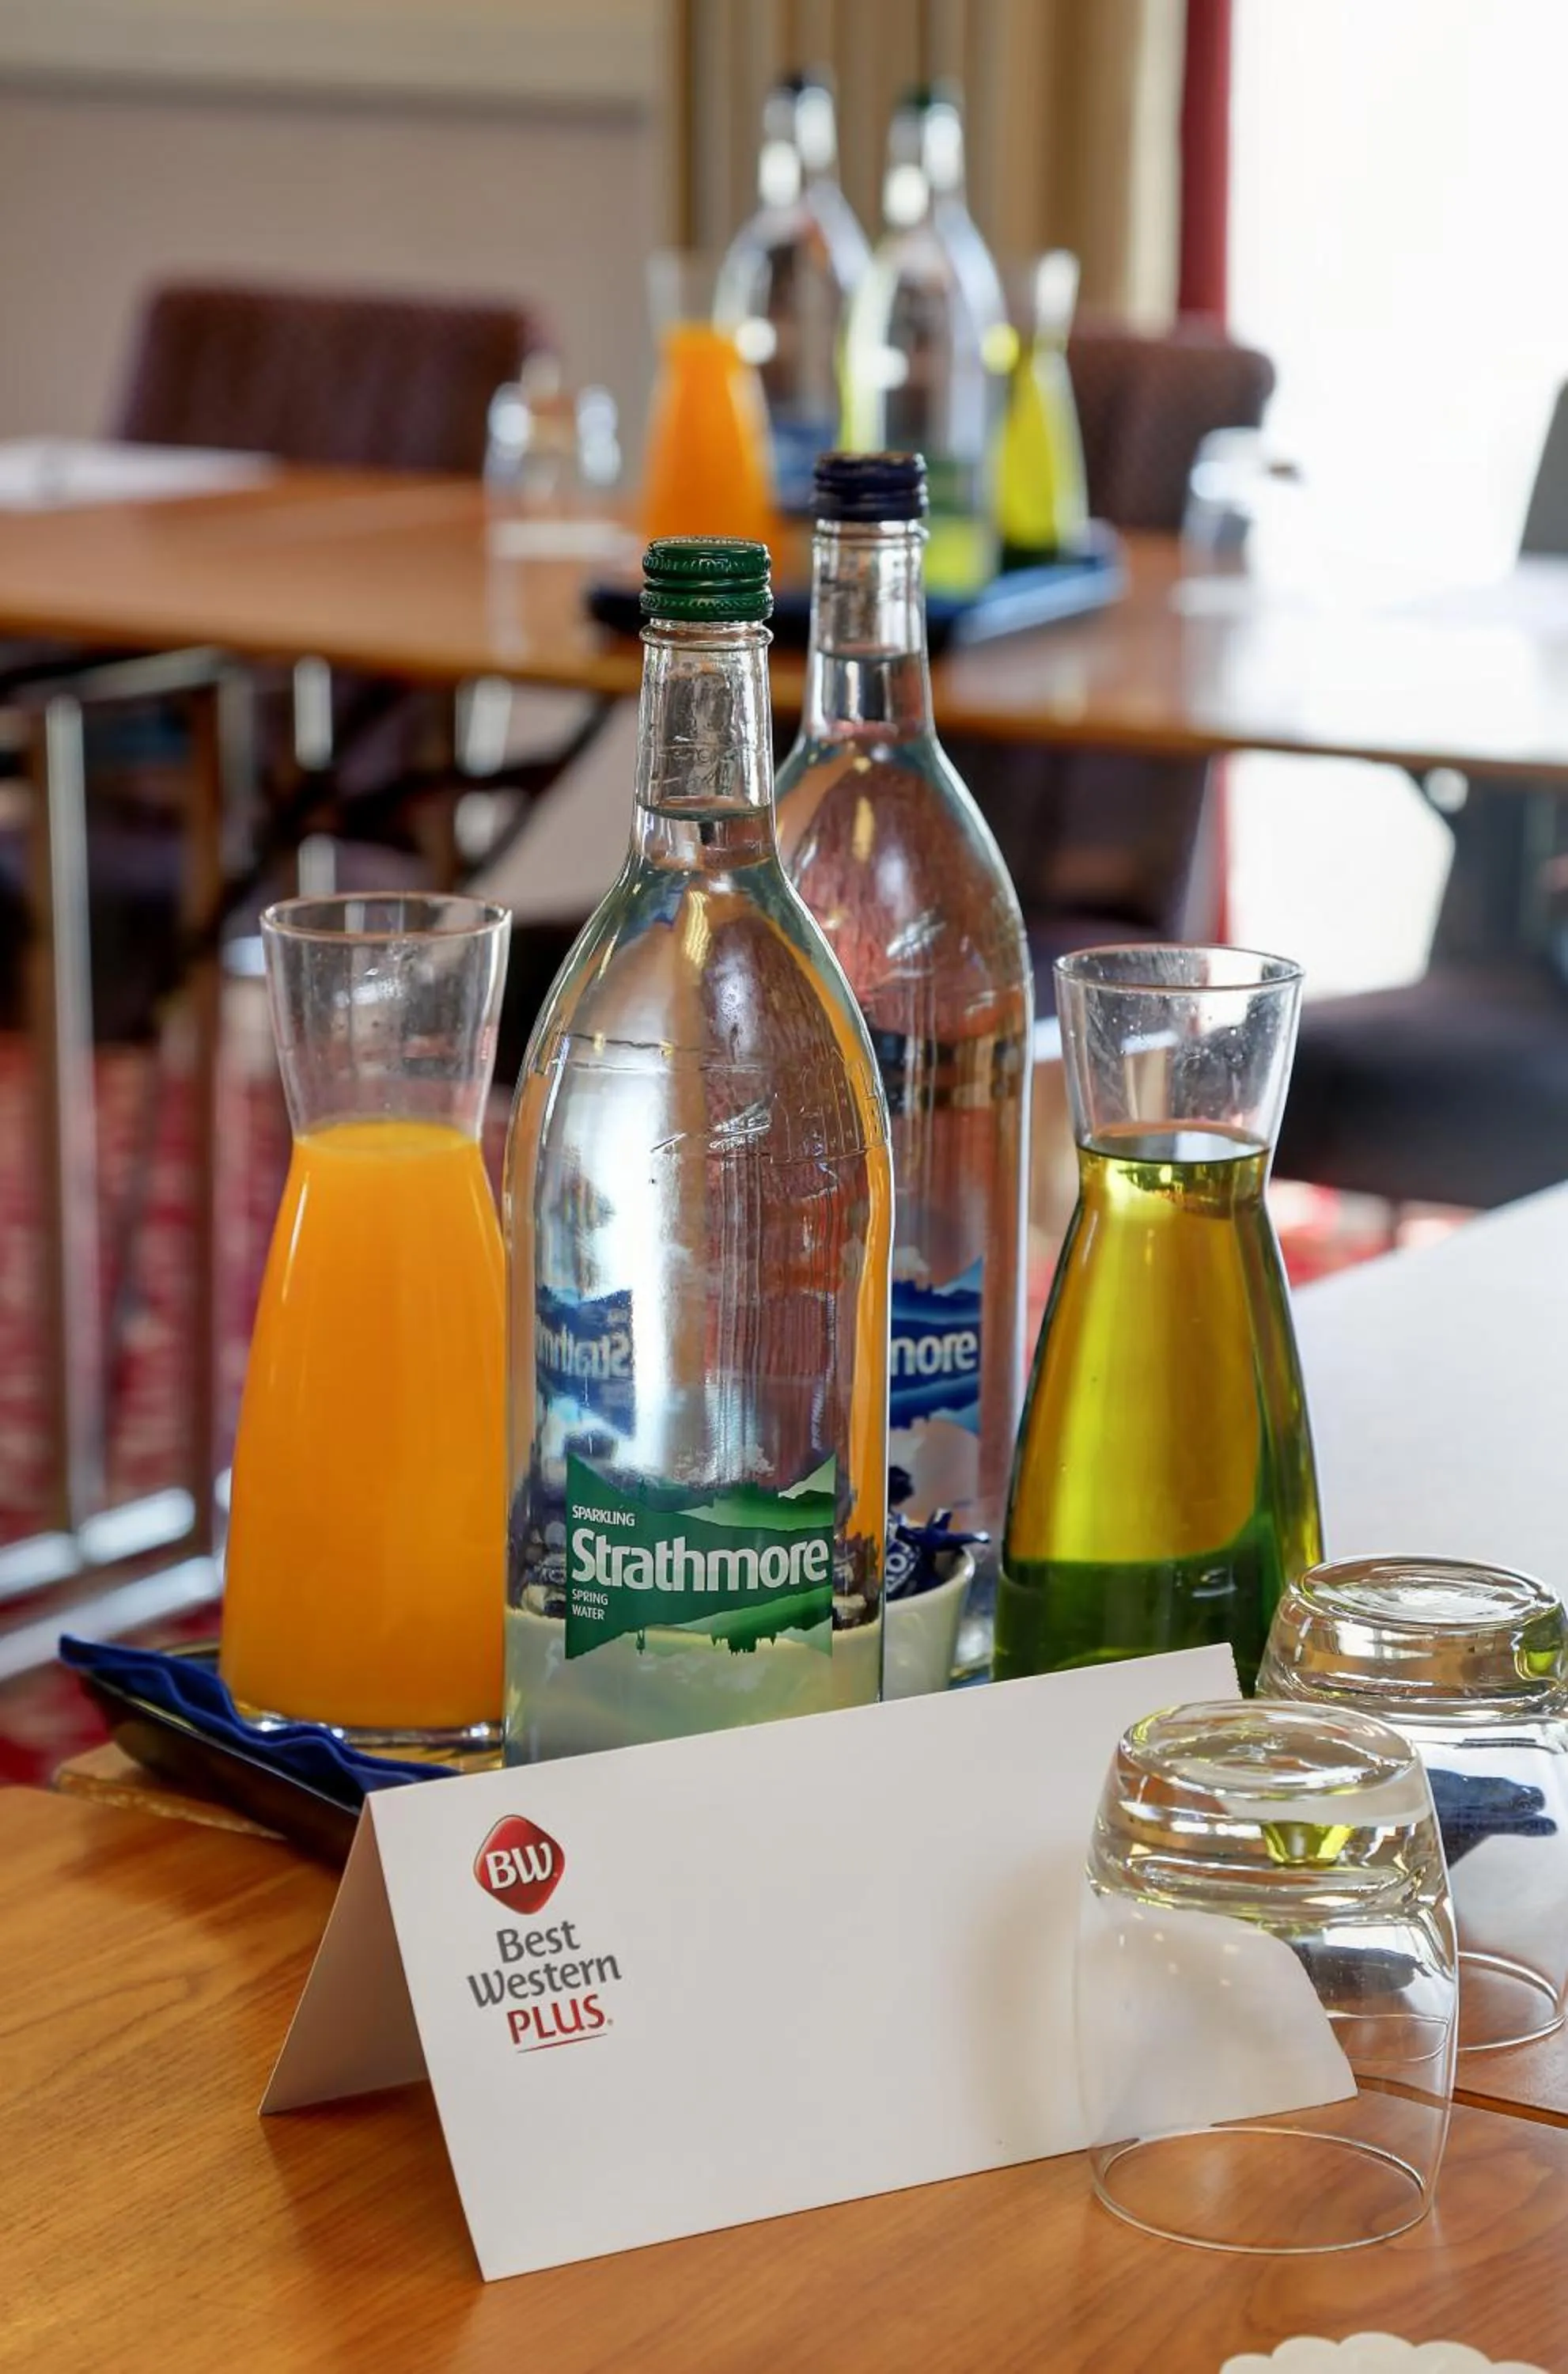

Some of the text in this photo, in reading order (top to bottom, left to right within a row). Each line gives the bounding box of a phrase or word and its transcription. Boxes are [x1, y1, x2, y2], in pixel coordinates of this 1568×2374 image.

[571, 1504, 636, 1527] SPARKLING
[571, 1527, 829, 1592] Strathmore
[571, 1588, 608, 1606] SPRING
[571, 1604, 605, 1621] WATER
[485, 1841, 554, 1890] BW
[496, 1920, 581, 1964] Best
[466, 1954, 623, 2009] Western
[506, 1993, 606, 2045] PLUS
